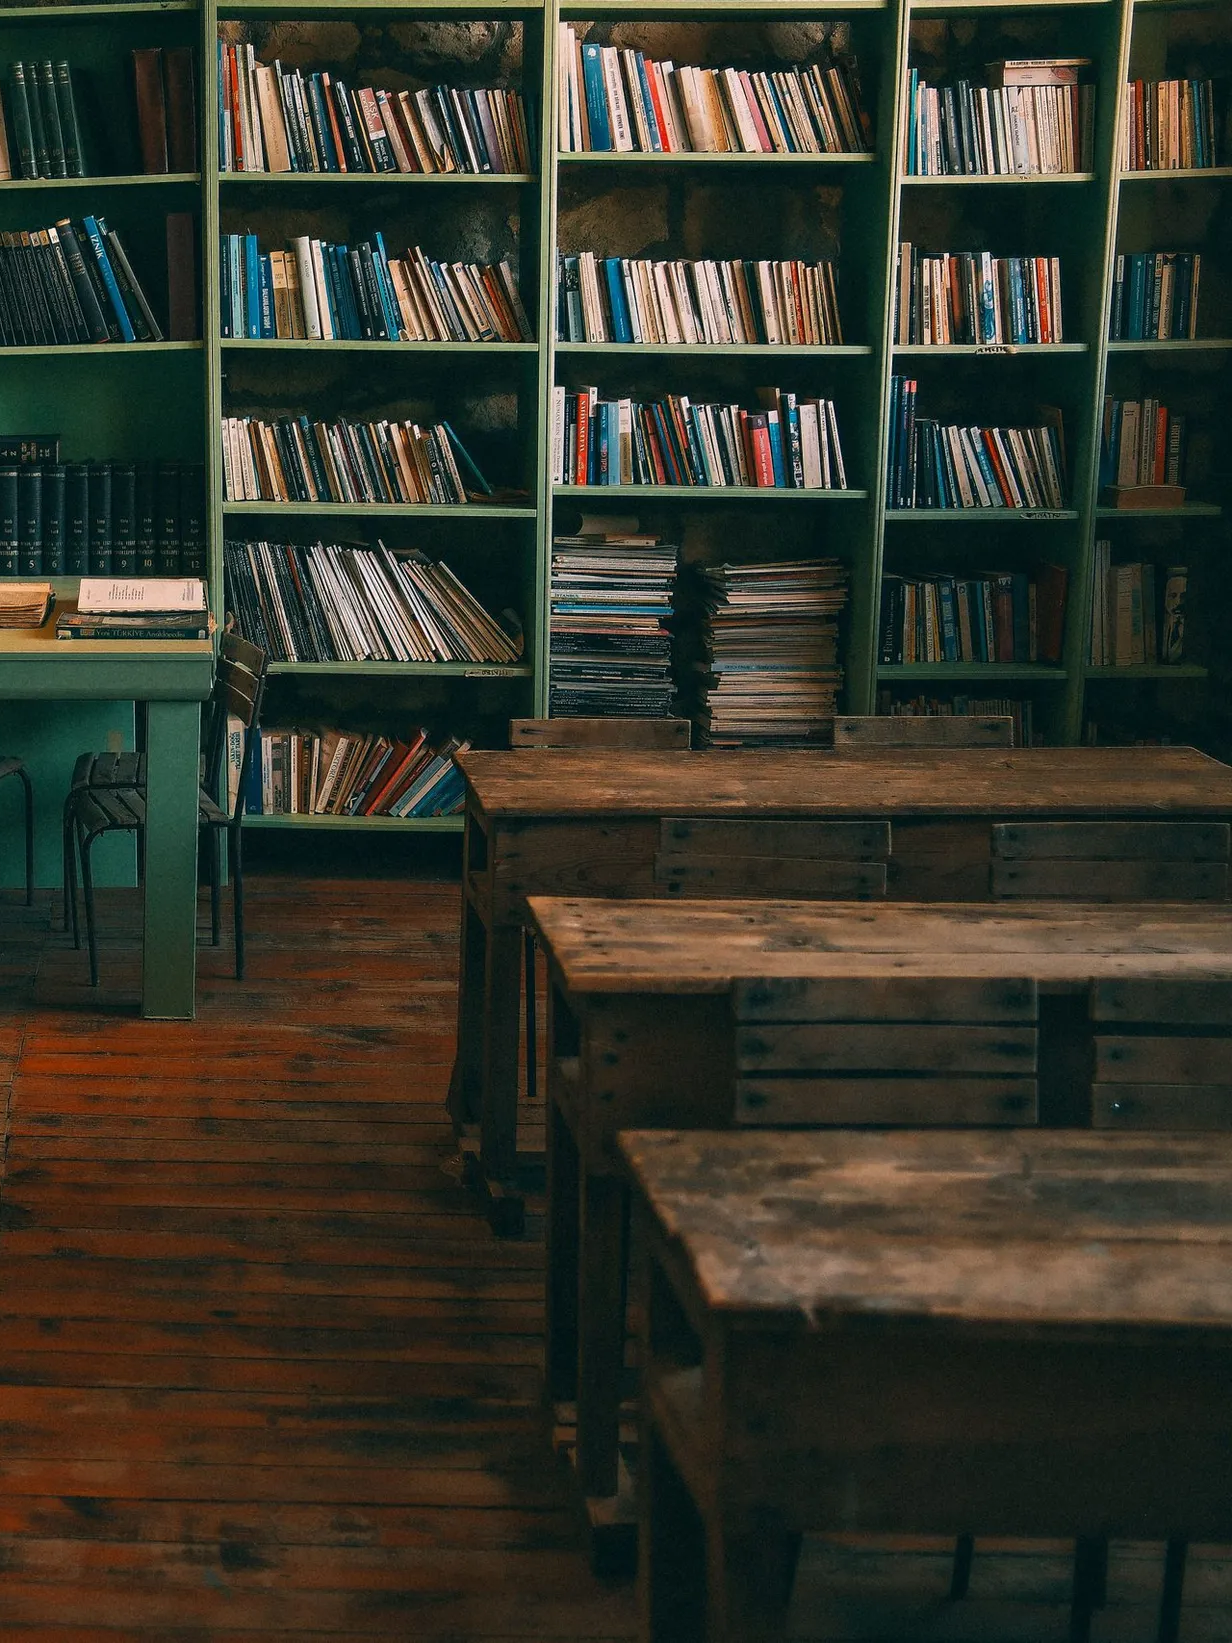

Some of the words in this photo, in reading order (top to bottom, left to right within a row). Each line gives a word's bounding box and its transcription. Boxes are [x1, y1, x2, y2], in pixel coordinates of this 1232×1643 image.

[89, 234, 105, 260] İZNİK
[6, 560, 12, 569] 4
[28, 560, 34, 569] 5
[52, 560, 58, 569] 6
[76, 560, 81, 569] 7
[99, 560, 104, 569] 8
[121, 560, 126, 569] 9
[144, 560, 152, 569] 10
[166, 560, 174, 569] 11
[191, 560, 200, 569] 12
[112, 628, 145, 638] TÜRKİYE
[327, 746, 344, 783] SARTORIS
